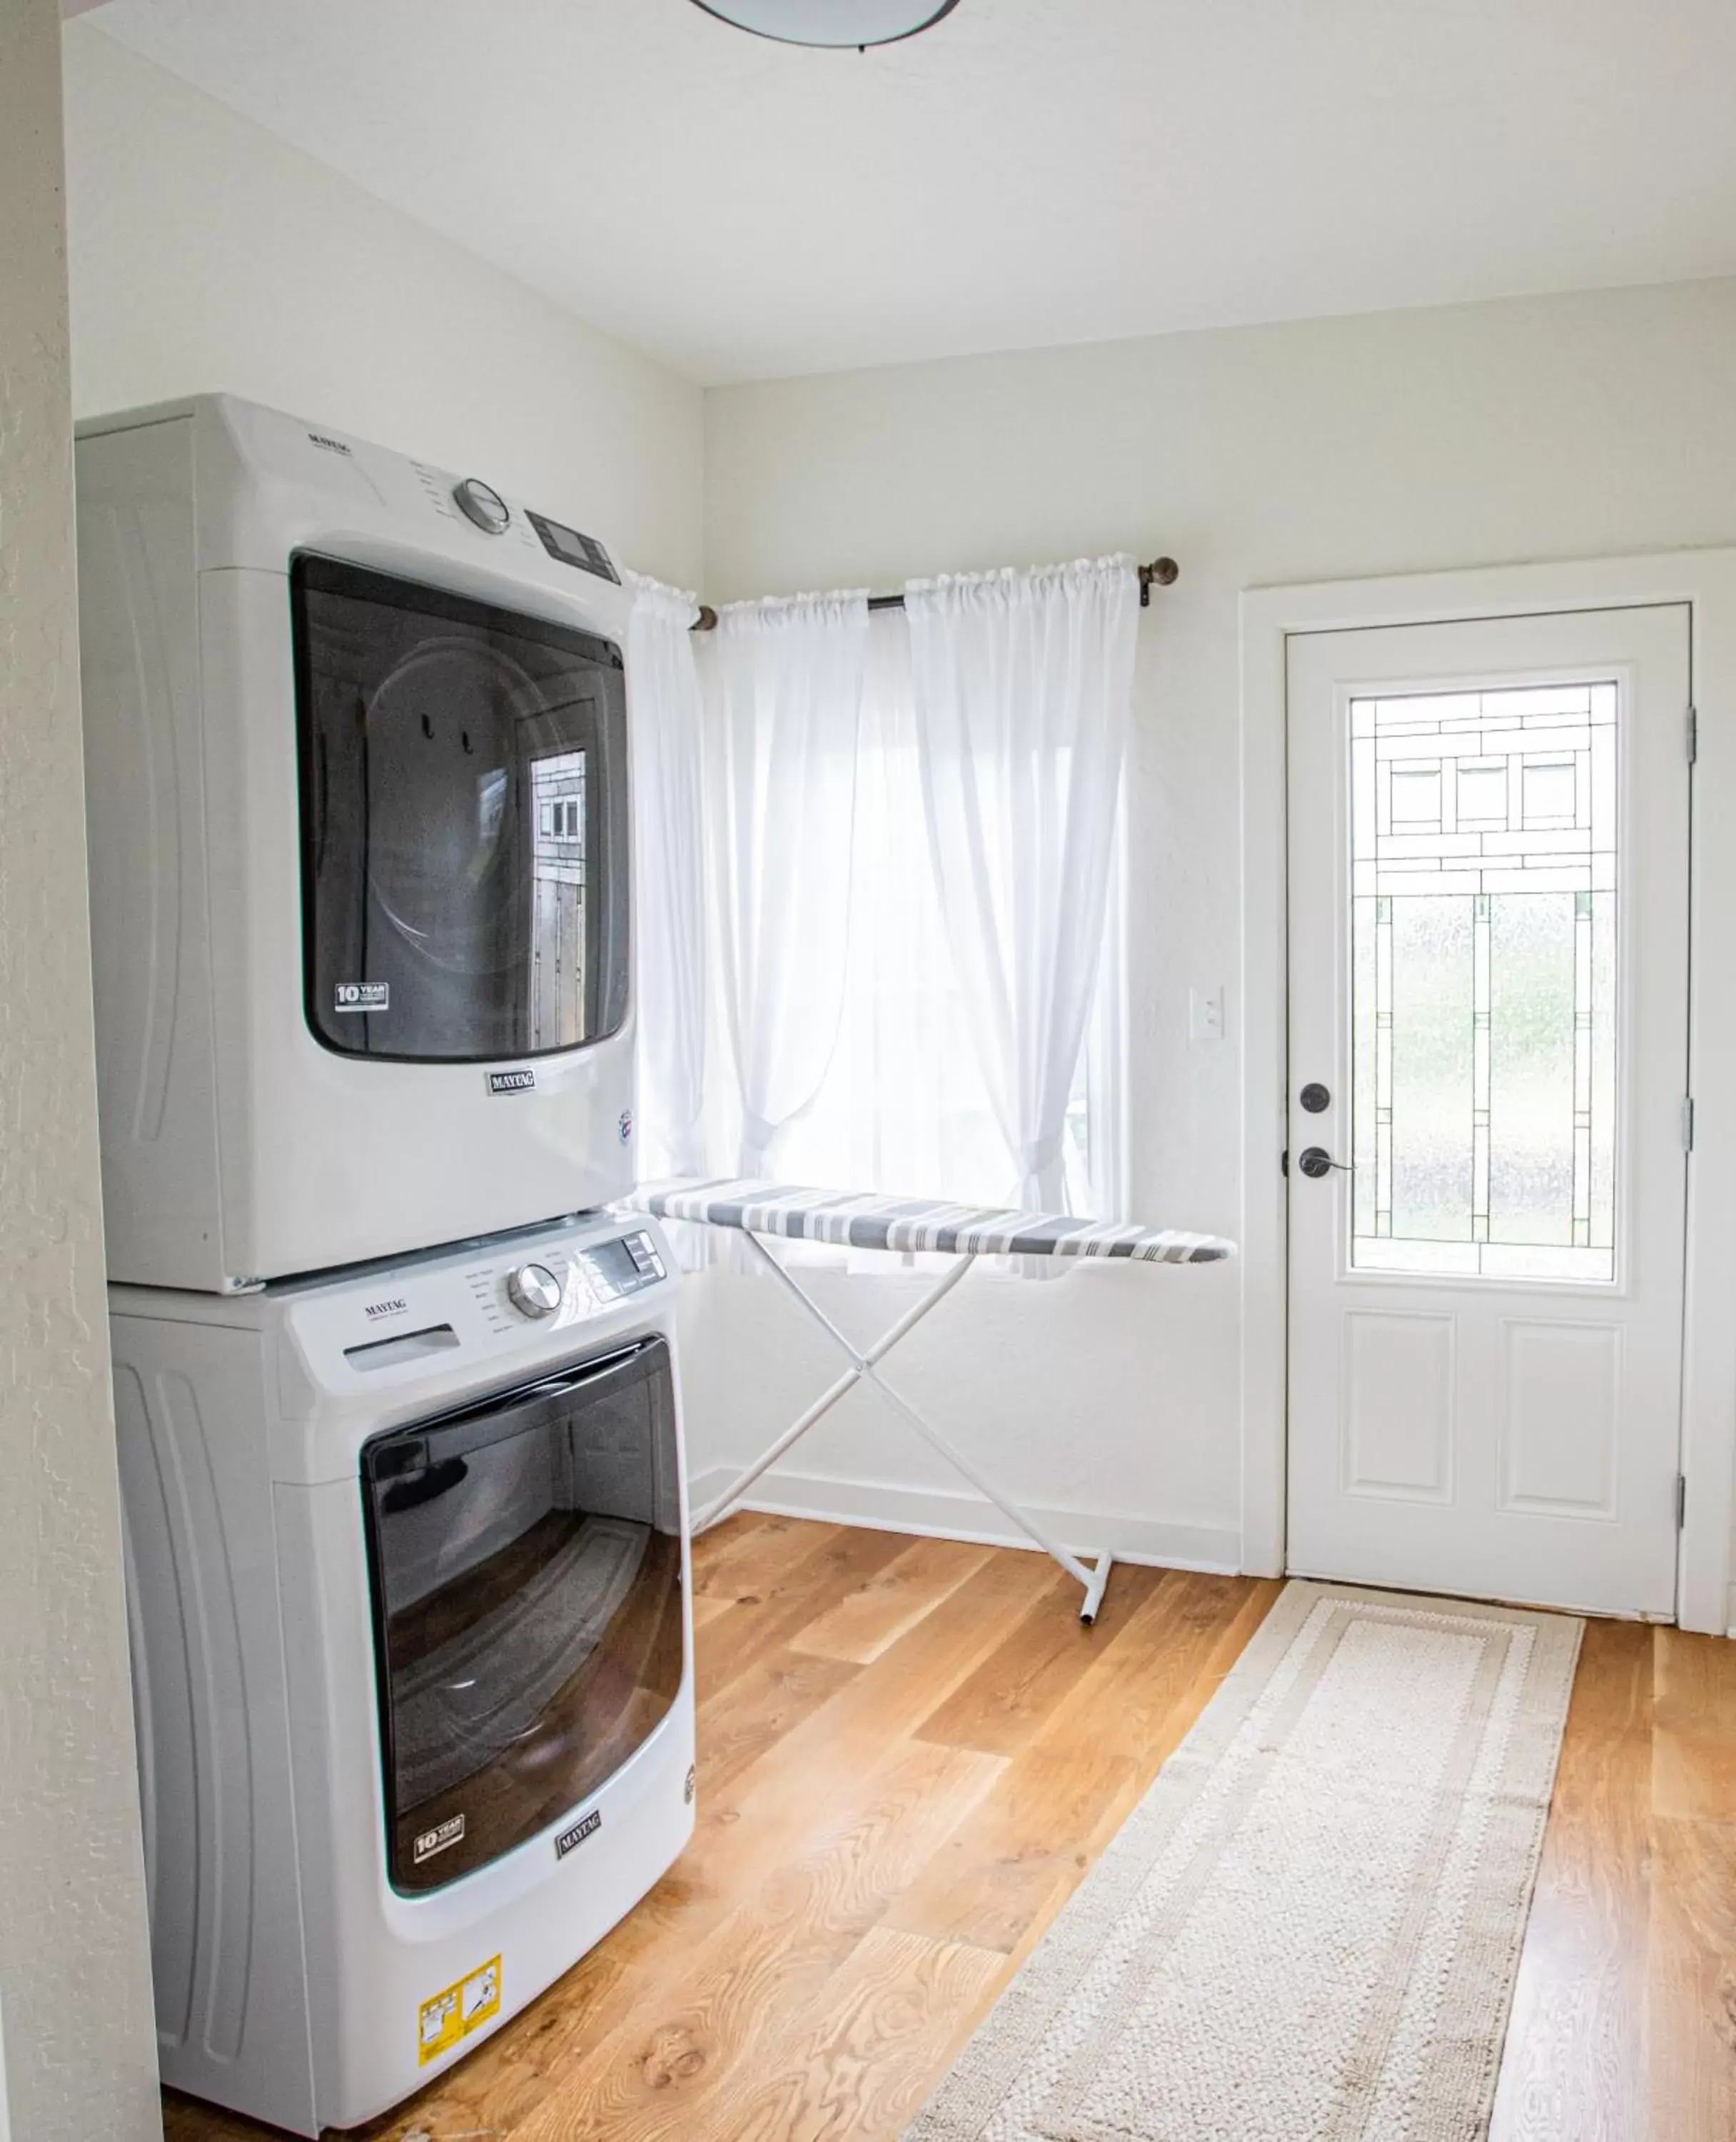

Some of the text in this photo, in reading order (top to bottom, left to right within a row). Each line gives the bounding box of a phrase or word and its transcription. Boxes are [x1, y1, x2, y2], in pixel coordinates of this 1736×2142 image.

[338, 986, 360, 1002] 10
[492, 1072, 534, 1089] MAYTAG
[365, 1299, 406, 1317] MAYTAG
[560, 1814, 600, 1851] MAYTAG
[417, 1832, 438, 1854] 10
